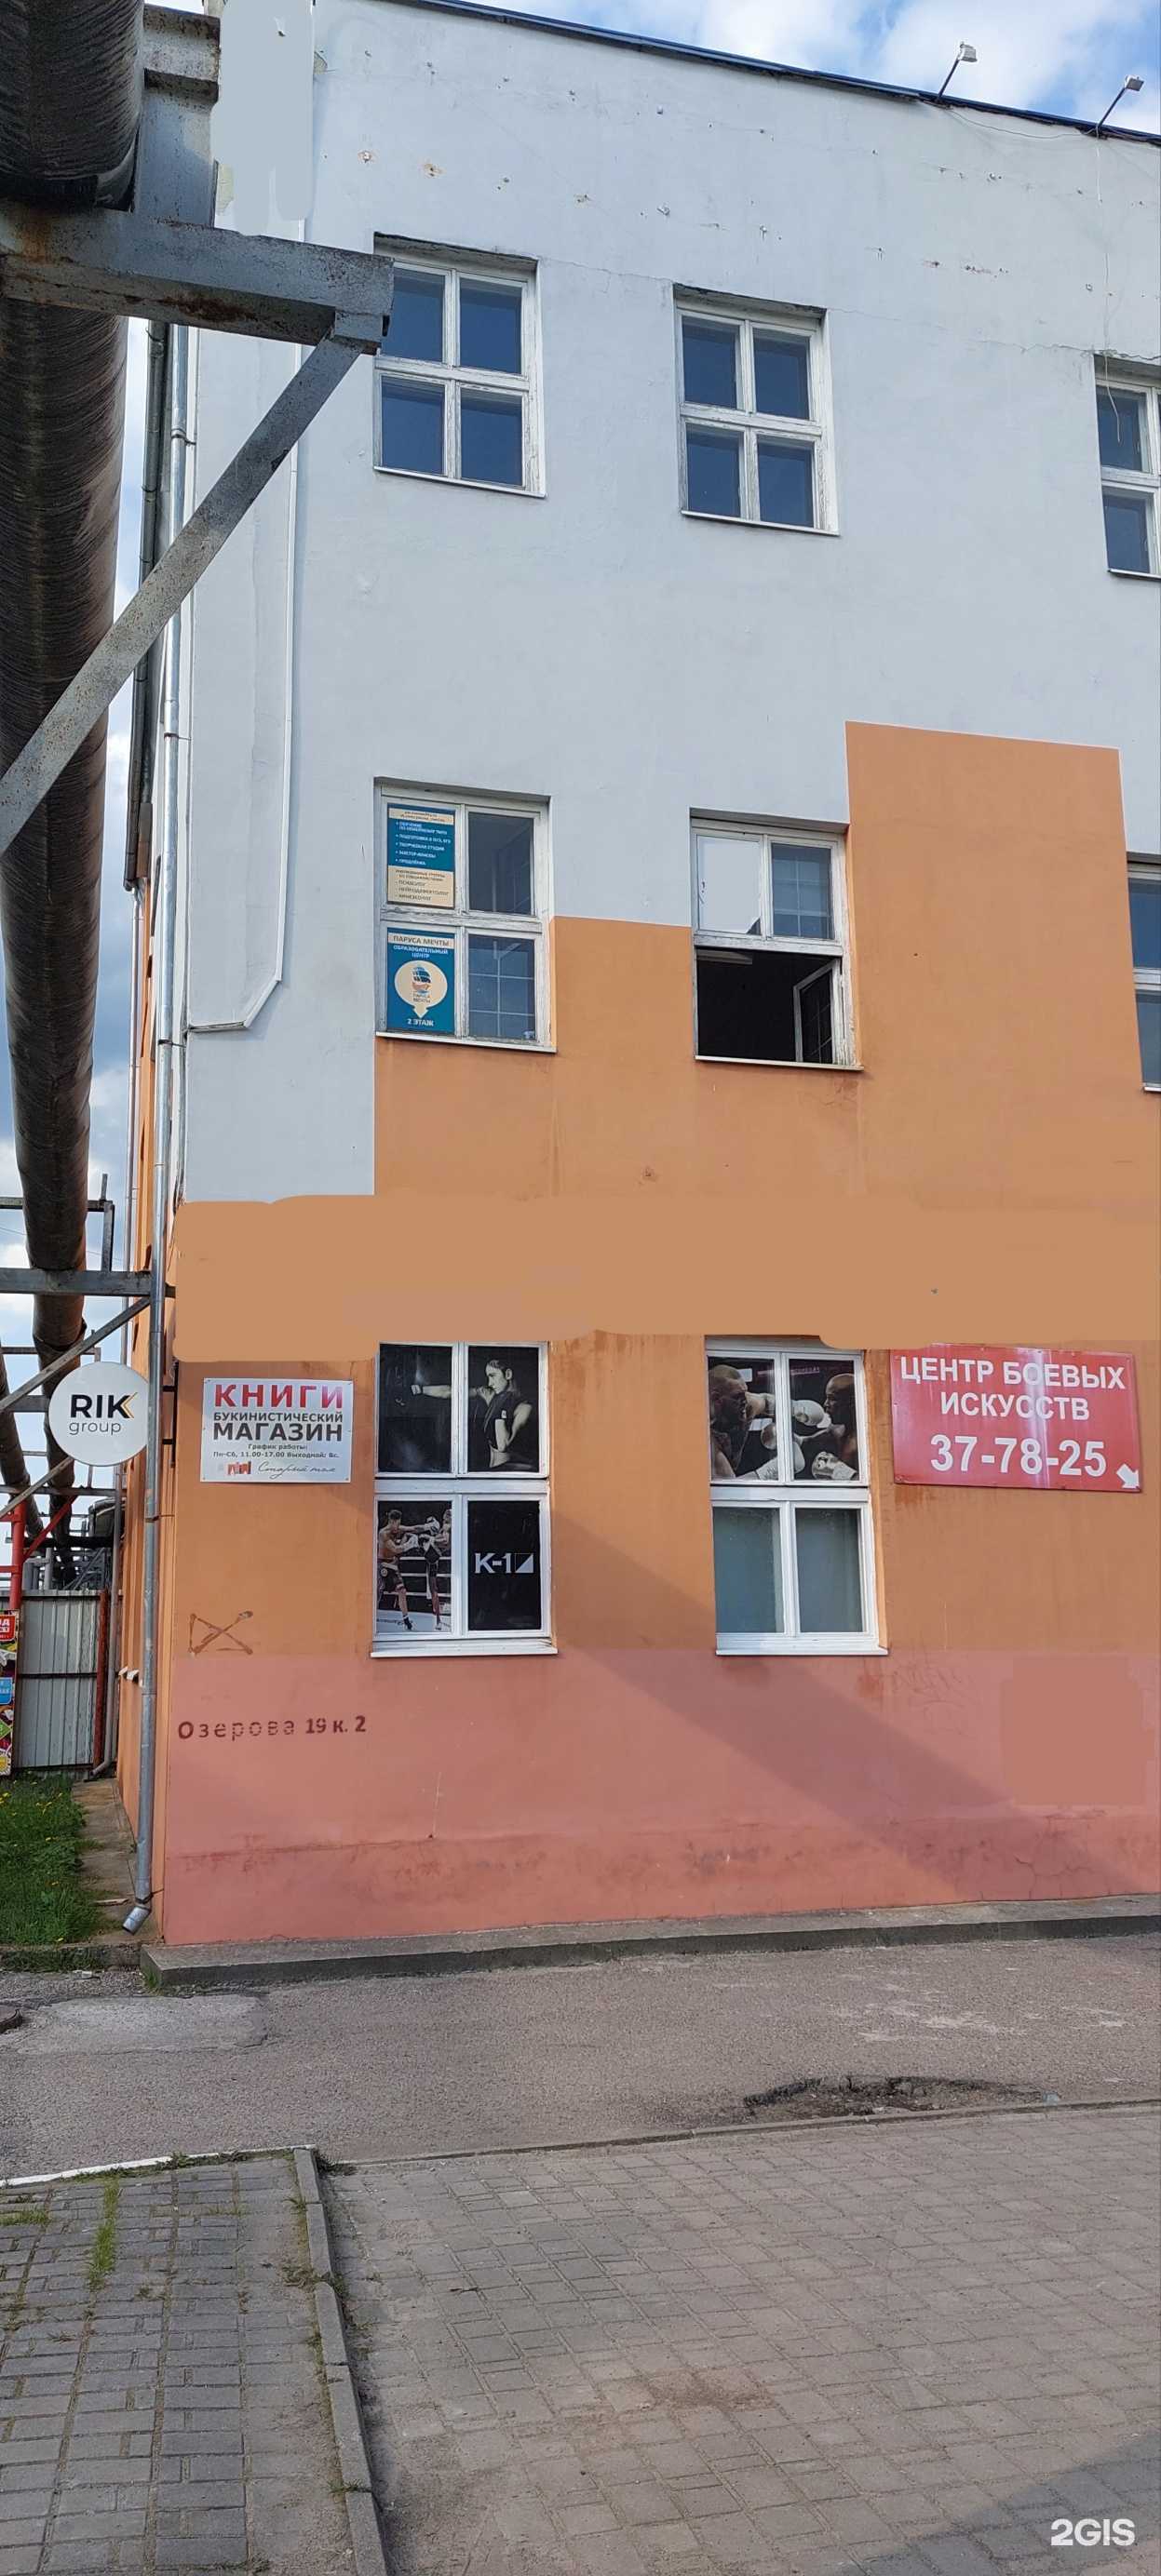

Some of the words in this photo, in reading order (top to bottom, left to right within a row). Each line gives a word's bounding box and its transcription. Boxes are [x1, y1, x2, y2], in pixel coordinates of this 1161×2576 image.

[393, 934, 422, 944] ПАРУСА
[423, 938, 450, 946] МЕЧТЫ
[393, 945, 449, 955] ОБРАЗОВАТЕЛЬНЫЙ
[900, 1356, 993, 1385] ЦЕНТР
[1003, 1362, 1126, 1389] БОЕВЫХ
[71, 1393, 132, 1419] RIK
[214, 1384, 343, 1409] КНИГИ
[940, 1391, 1089, 1421] ИСКУССТВ
[69, 1422, 122, 1436] group
[213, 1412, 344, 1423] БУКИНИСТИЧЕСКИЙ
[213, 1423, 342, 1442] МАГАЗИН
[930, 1434, 1107, 1477] 37-78-25
[475, 1552, 511, 1574] K-1
[178, 1720, 294, 1741] Озерова
[305, 1718, 327, 1734] 19
[355, 1715, 367, 1733] 2
